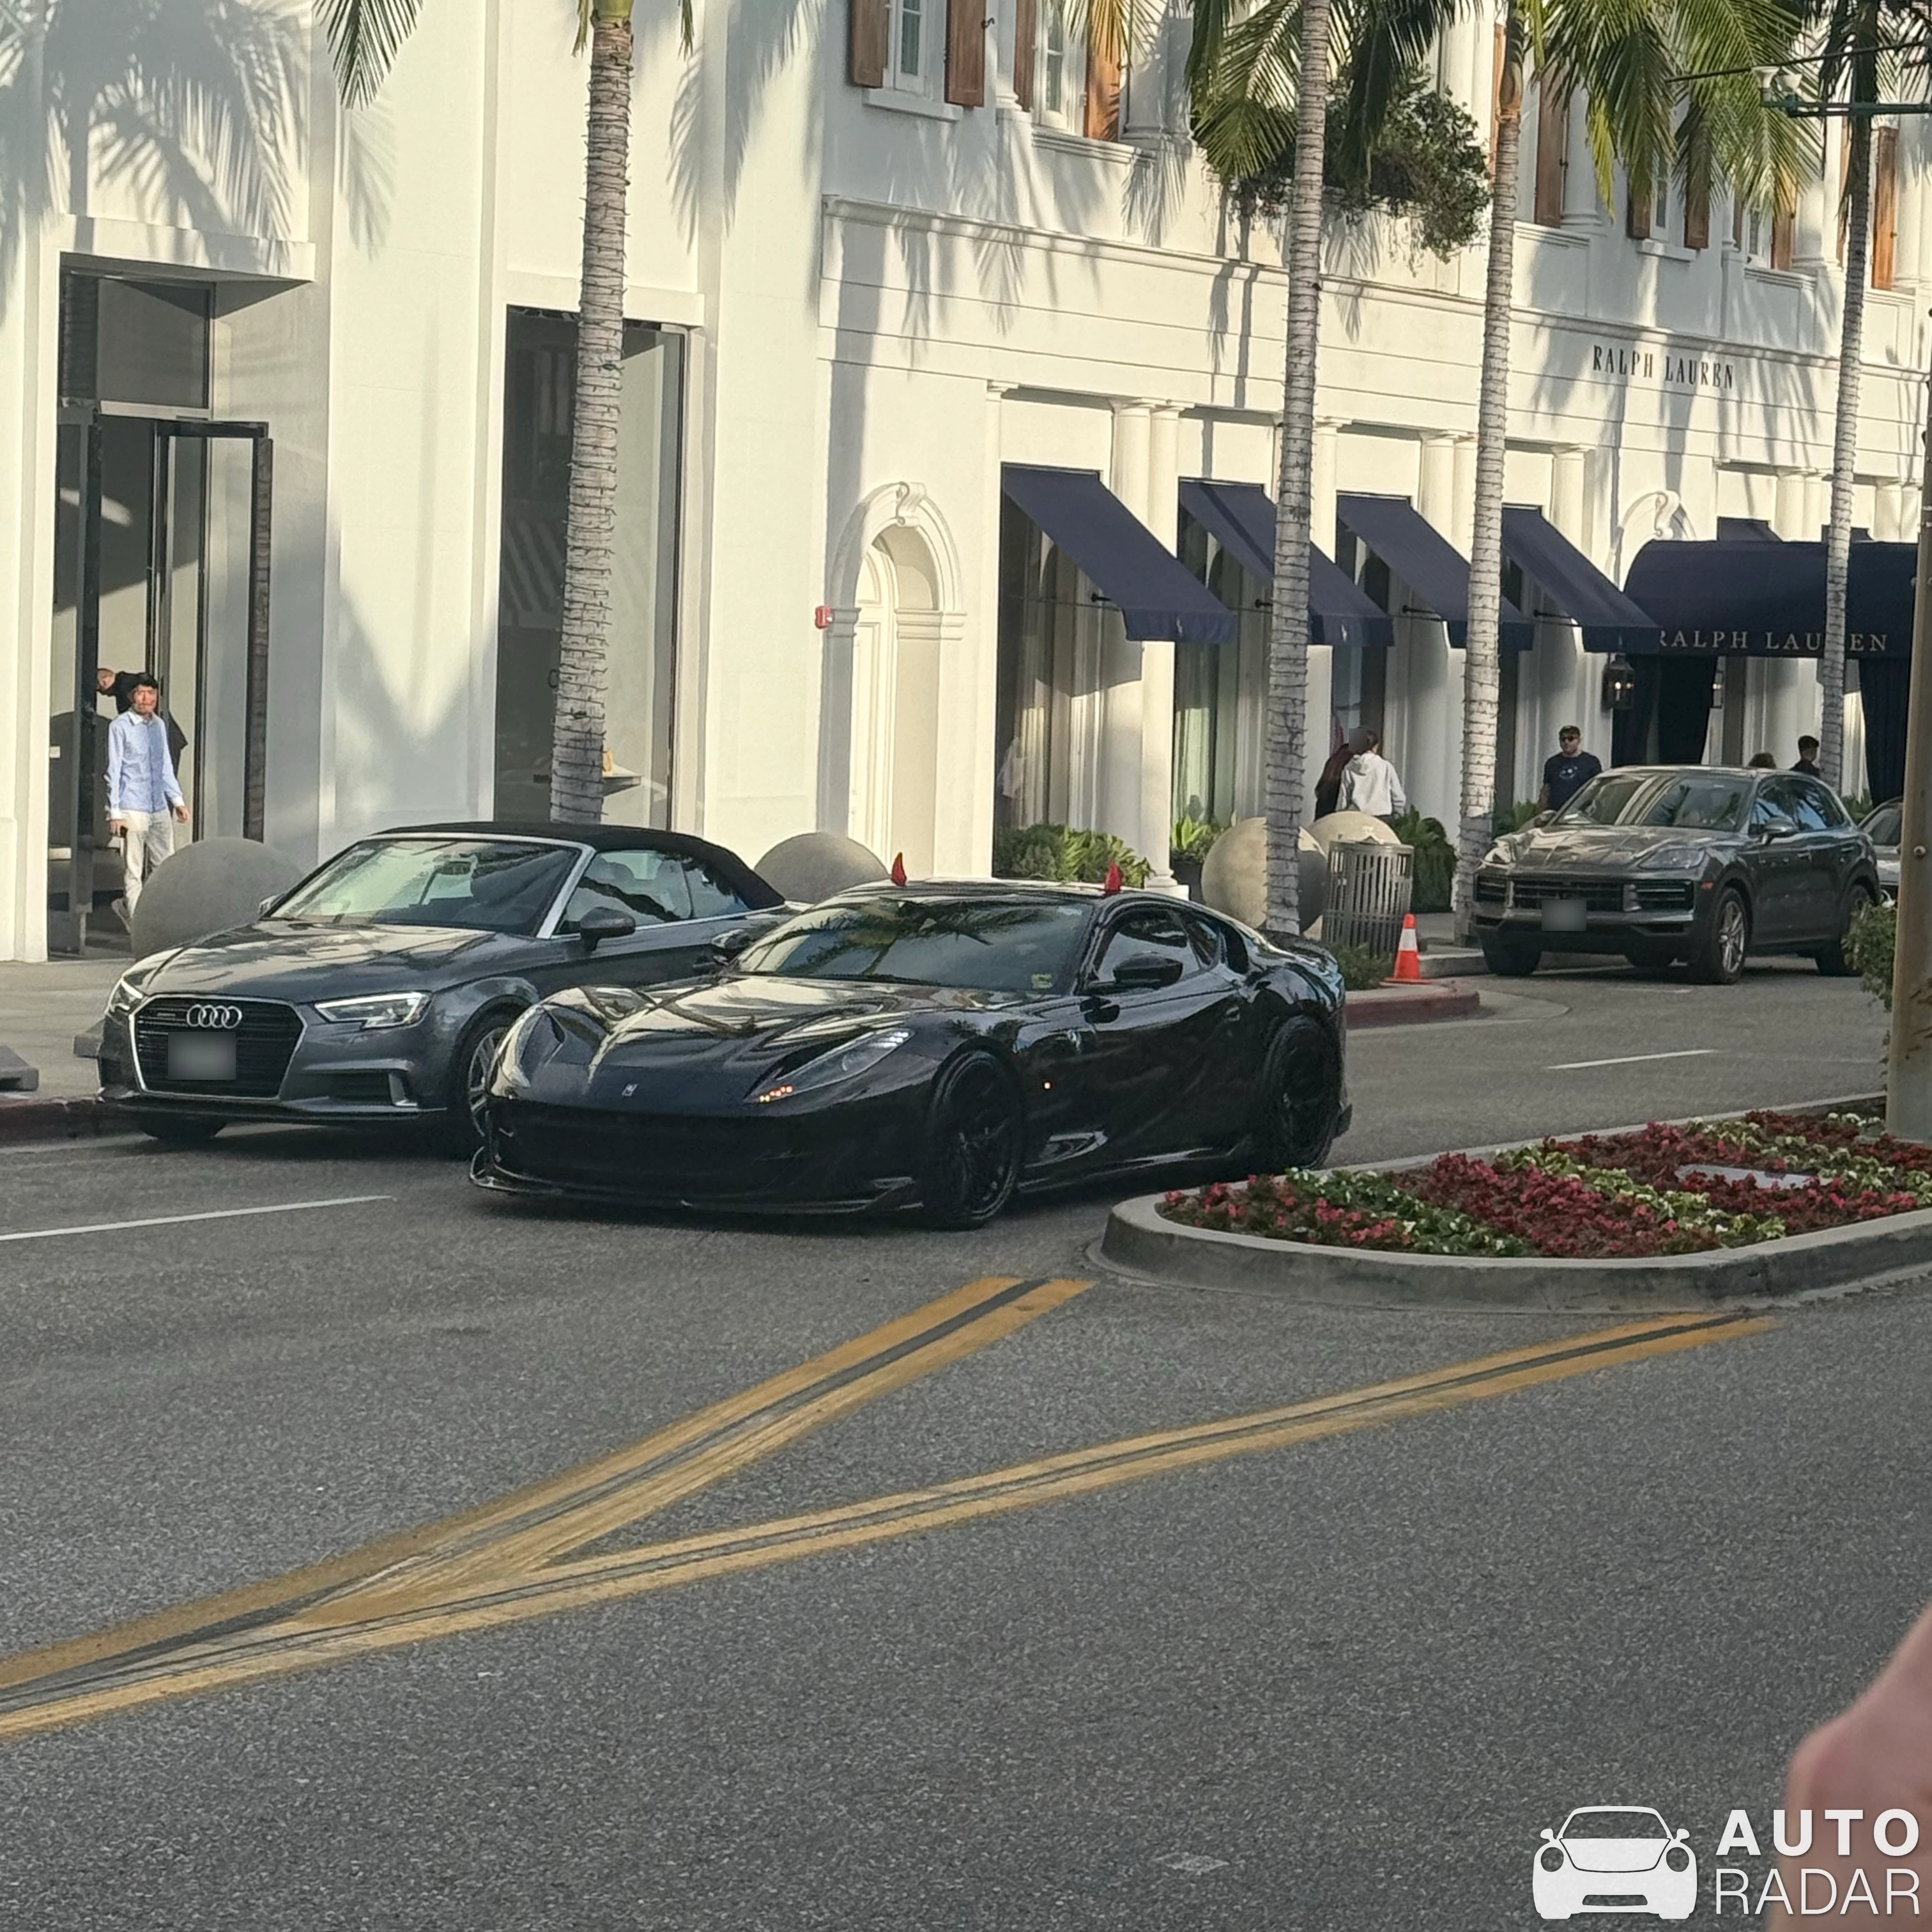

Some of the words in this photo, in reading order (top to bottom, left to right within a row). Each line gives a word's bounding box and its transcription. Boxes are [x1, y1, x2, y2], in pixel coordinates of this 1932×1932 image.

[1592, 344, 1653, 378] RALPH
[1659, 629, 1749, 649] RALPH
[1765, 631, 1888, 652] LAUEN
